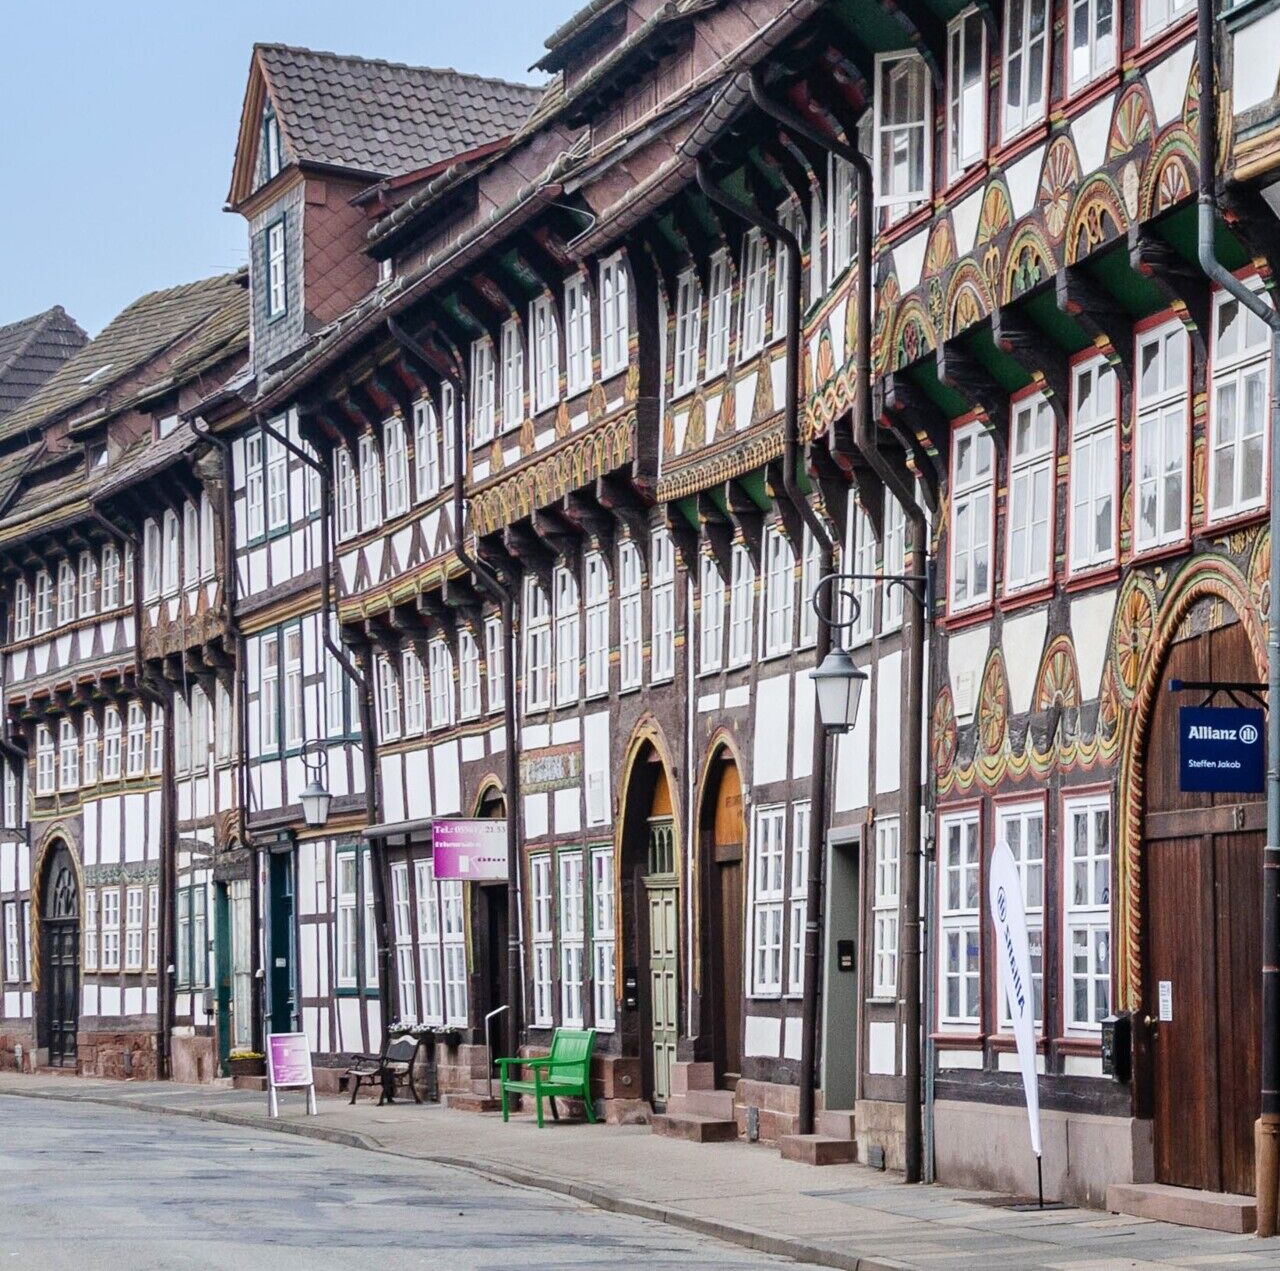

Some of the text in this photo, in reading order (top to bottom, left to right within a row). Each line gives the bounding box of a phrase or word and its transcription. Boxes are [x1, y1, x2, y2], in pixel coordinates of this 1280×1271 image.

[1188, 725, 1238, 740] Allianz
[1188, 759, 1241, 769] Steffen Jakob
